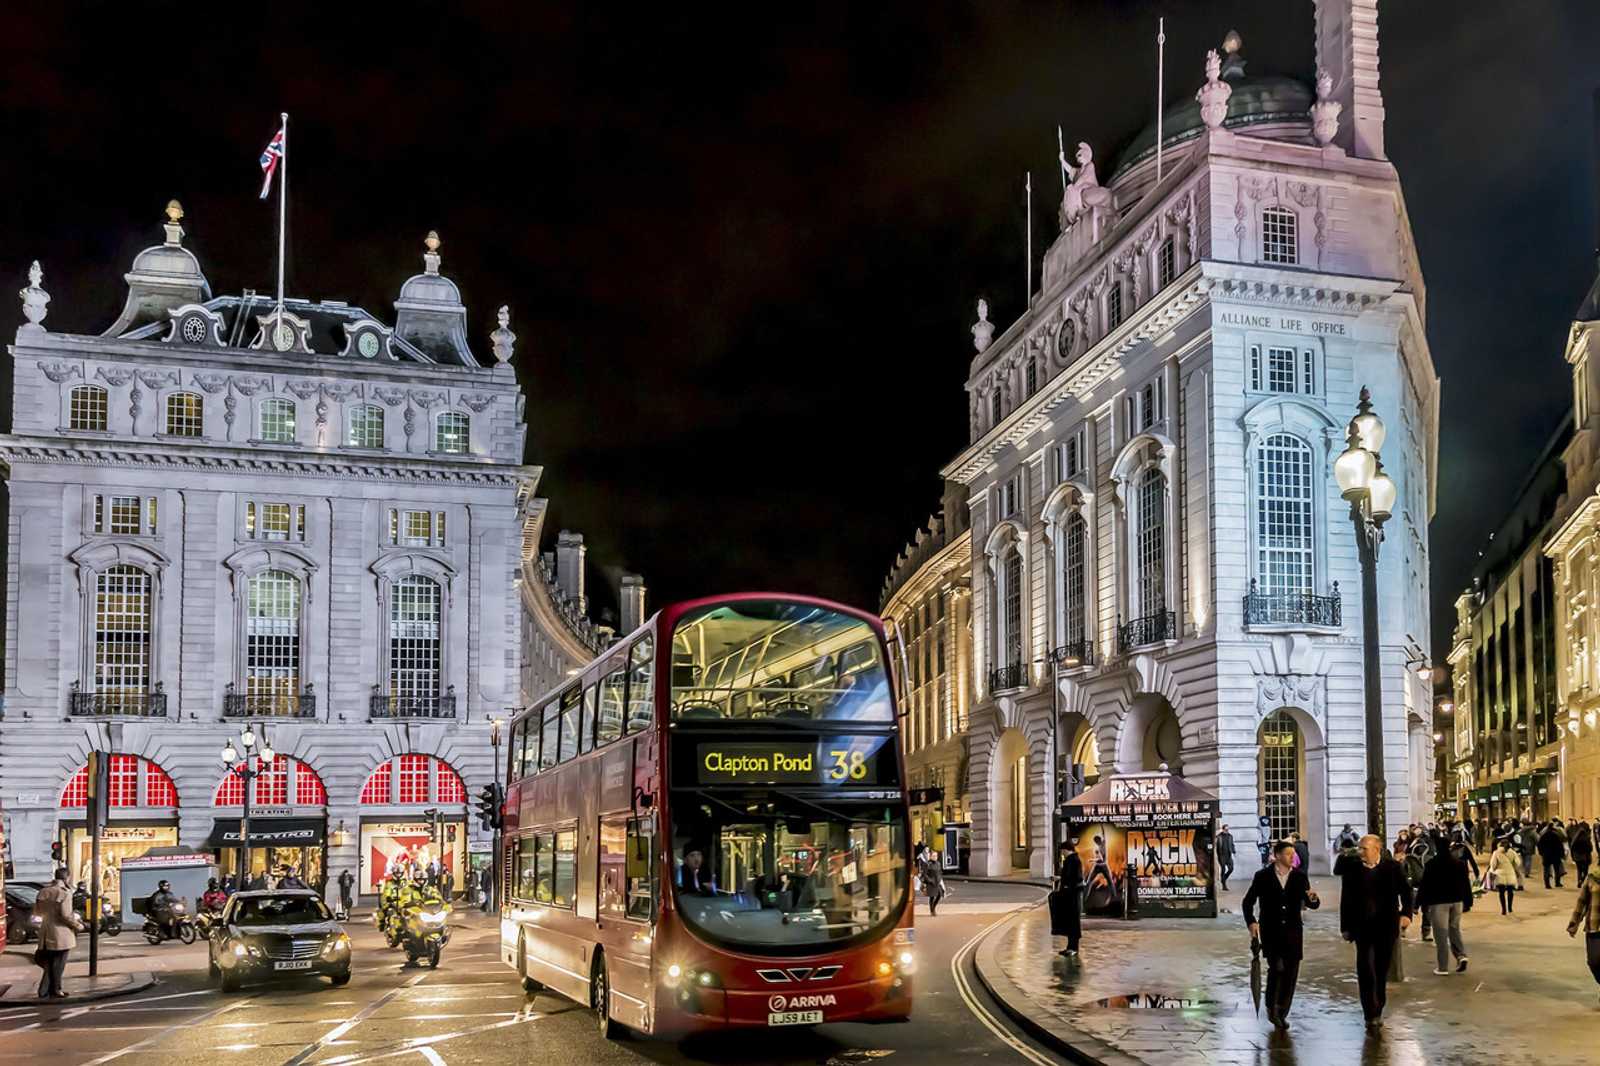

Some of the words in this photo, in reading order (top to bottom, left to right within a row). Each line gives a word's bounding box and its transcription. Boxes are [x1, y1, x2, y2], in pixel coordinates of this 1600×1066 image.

[1220, 312, 1271, 328] ALLIANCE
[1280, 318, 1303, 331] LIFE
[1311, 321, 1346, 336] OFFICE
[704, 752, 769, 776] Clapton
[773, 753, 813, 772] Pond
[830, 750, 868, 780] 38
[1082, 804, 1095, 816] WE
[1097, 804, 1117, 815] WILL
[1134, 802, 1153, 814] WILL
[1181, 801, 1198, 813] YOU
[1070, 815, 1087, 823] HALF
[1088, 814, 1108, 823] PRICE
[1173, 812, 1192, 820] HERE
[1126, 829, 1198, 876] ROCK
[1161, 863, 1198, 876] YOU
[1137, 887, 1174, 895] DOMINION
[1175, 886, 1207, 895] THEATRE
[789, 995, 837, 1008] ARRIVA
[772, 1012, 798, 1024] LJ59
[801, 1012, 819, 1022] AET
